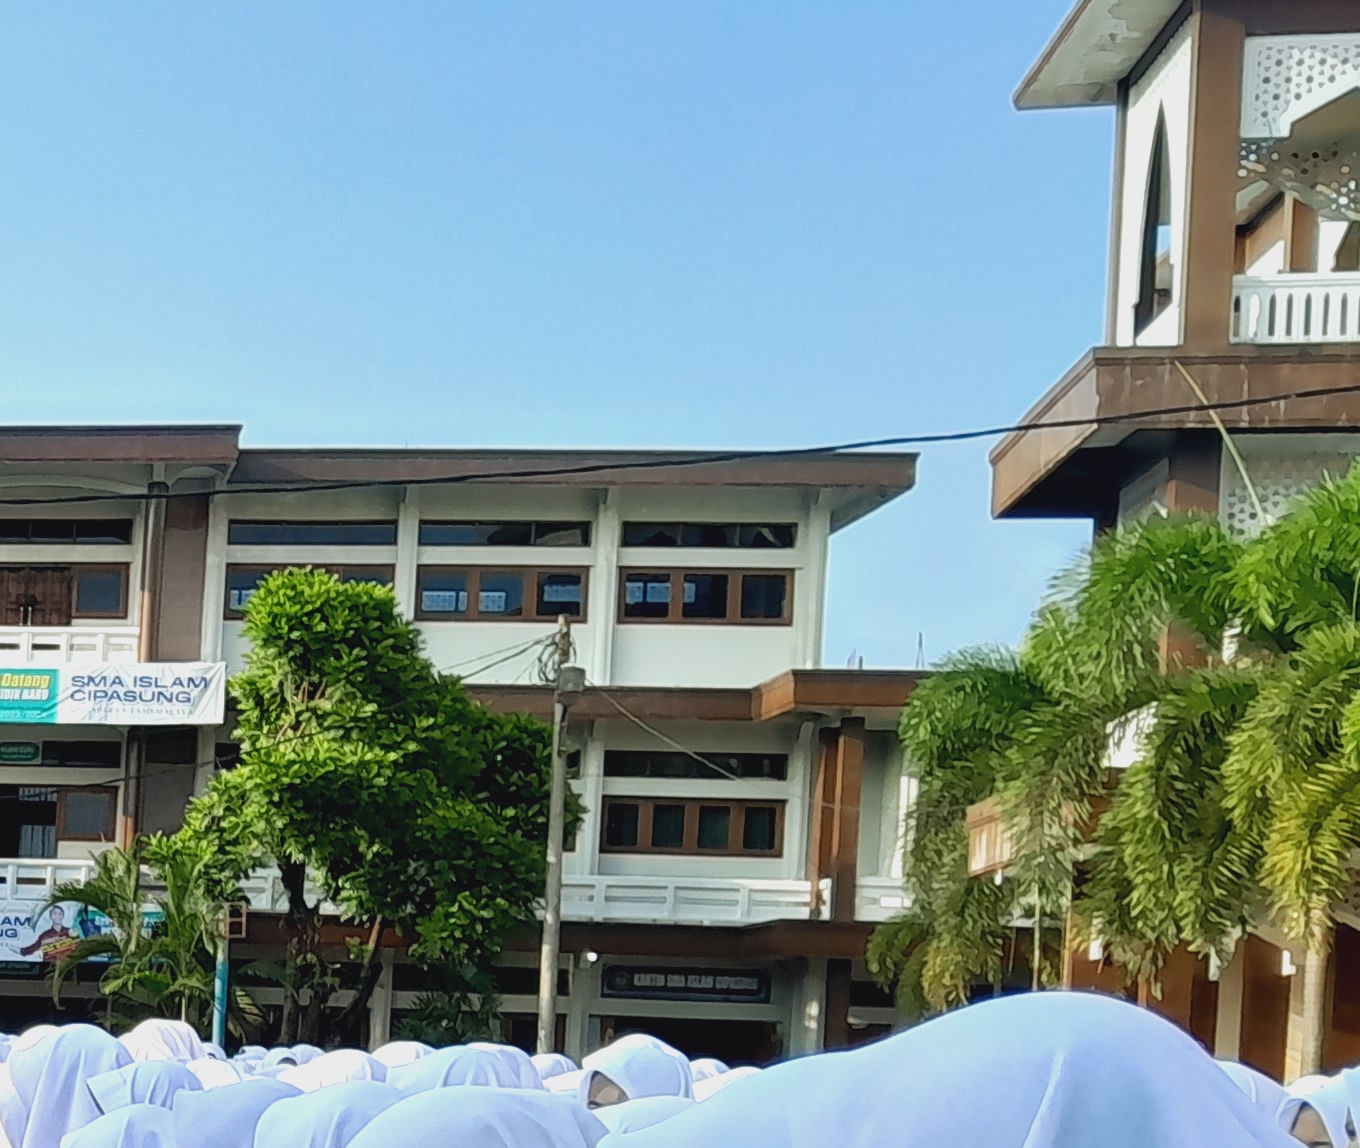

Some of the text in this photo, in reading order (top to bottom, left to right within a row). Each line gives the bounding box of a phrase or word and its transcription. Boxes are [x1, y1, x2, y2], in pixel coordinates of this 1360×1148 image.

[1, 673, 51, 689] Datang
[71, 675, 209, 689] SMA ISLAM
[70, 690, 192, 704] CIPASUNG
